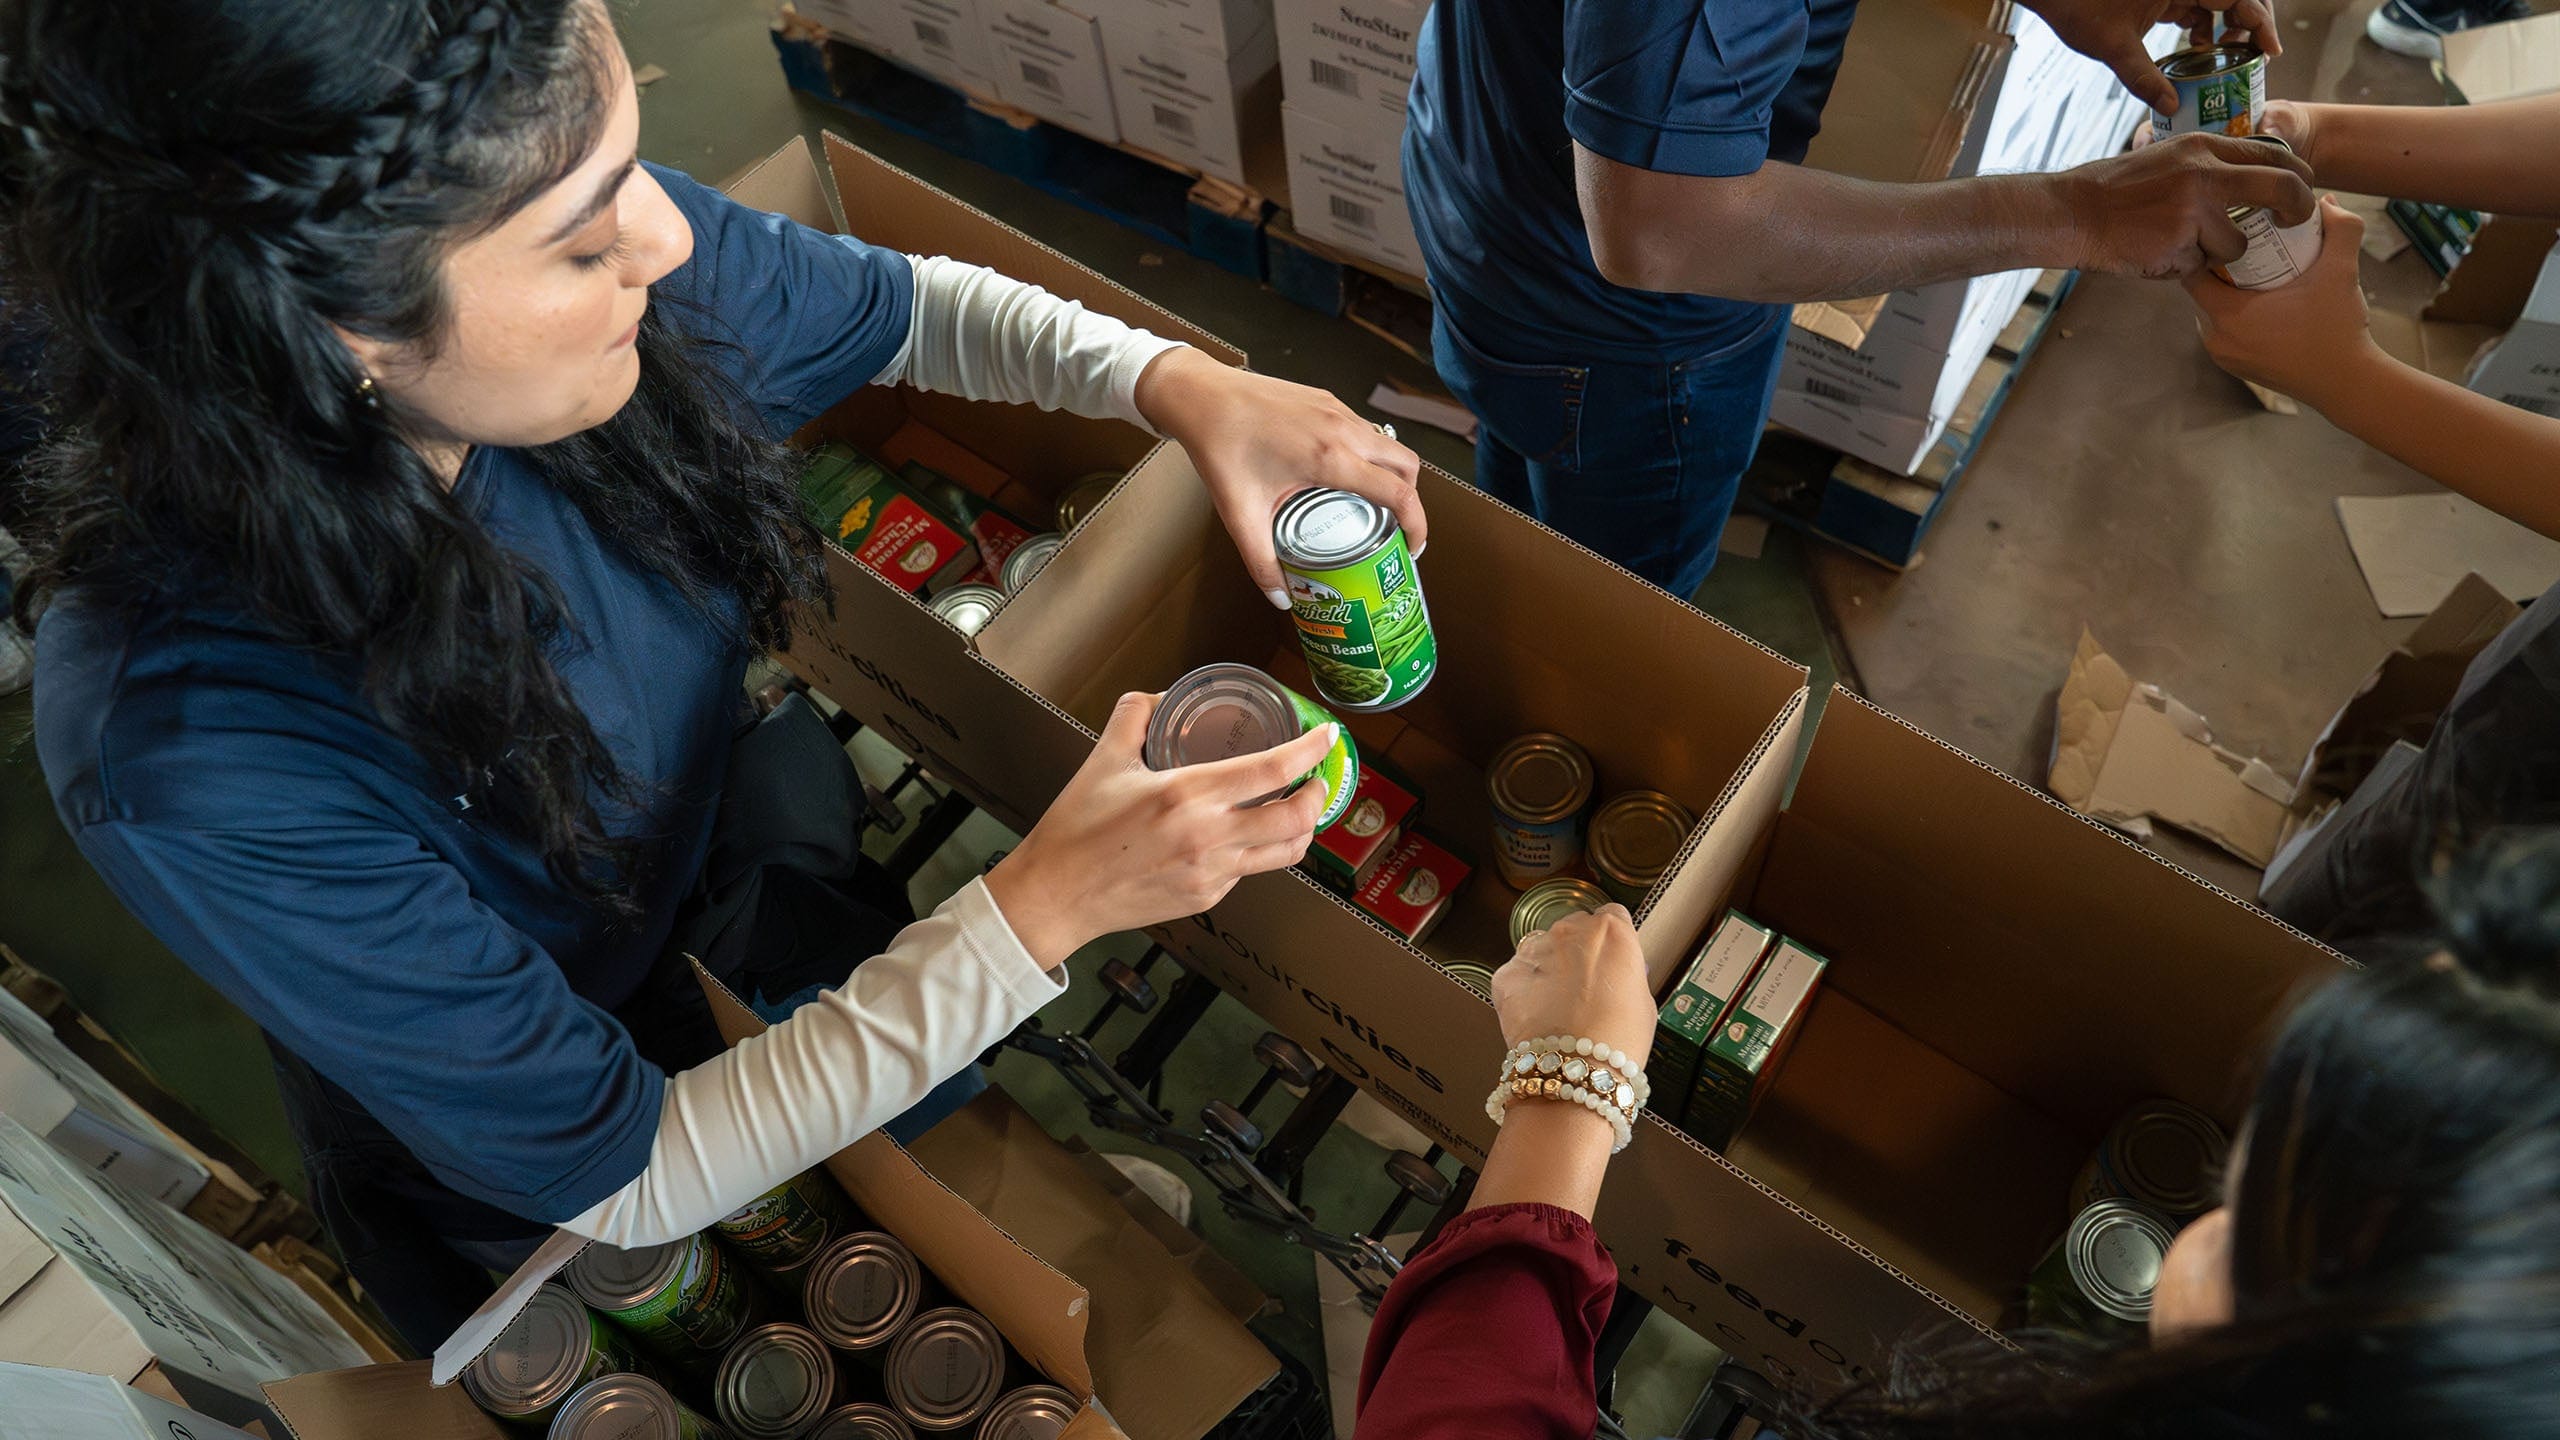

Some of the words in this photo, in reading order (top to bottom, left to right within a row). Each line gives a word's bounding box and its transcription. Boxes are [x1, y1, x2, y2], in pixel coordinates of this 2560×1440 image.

[1340, 6, 1410, 41] NeoStar
[2203, 94, 2226, 109] 60
[864, 521, 909, 559] Cheese
[871, 517, 931, 570] Macaroni
[1383, 559, 1400, 583] 20
[1291, 603, 1353, 624] rfield
[1330, 642, 1375, 656] Beans
[1364, 841, 1423, 905] Macaroni
[1683, 996, 1710, 1031] Macaroni
[1696, 1001, 1717, 1029] Cheese
[1738, 1024, 1765, 1059] Macaroni
